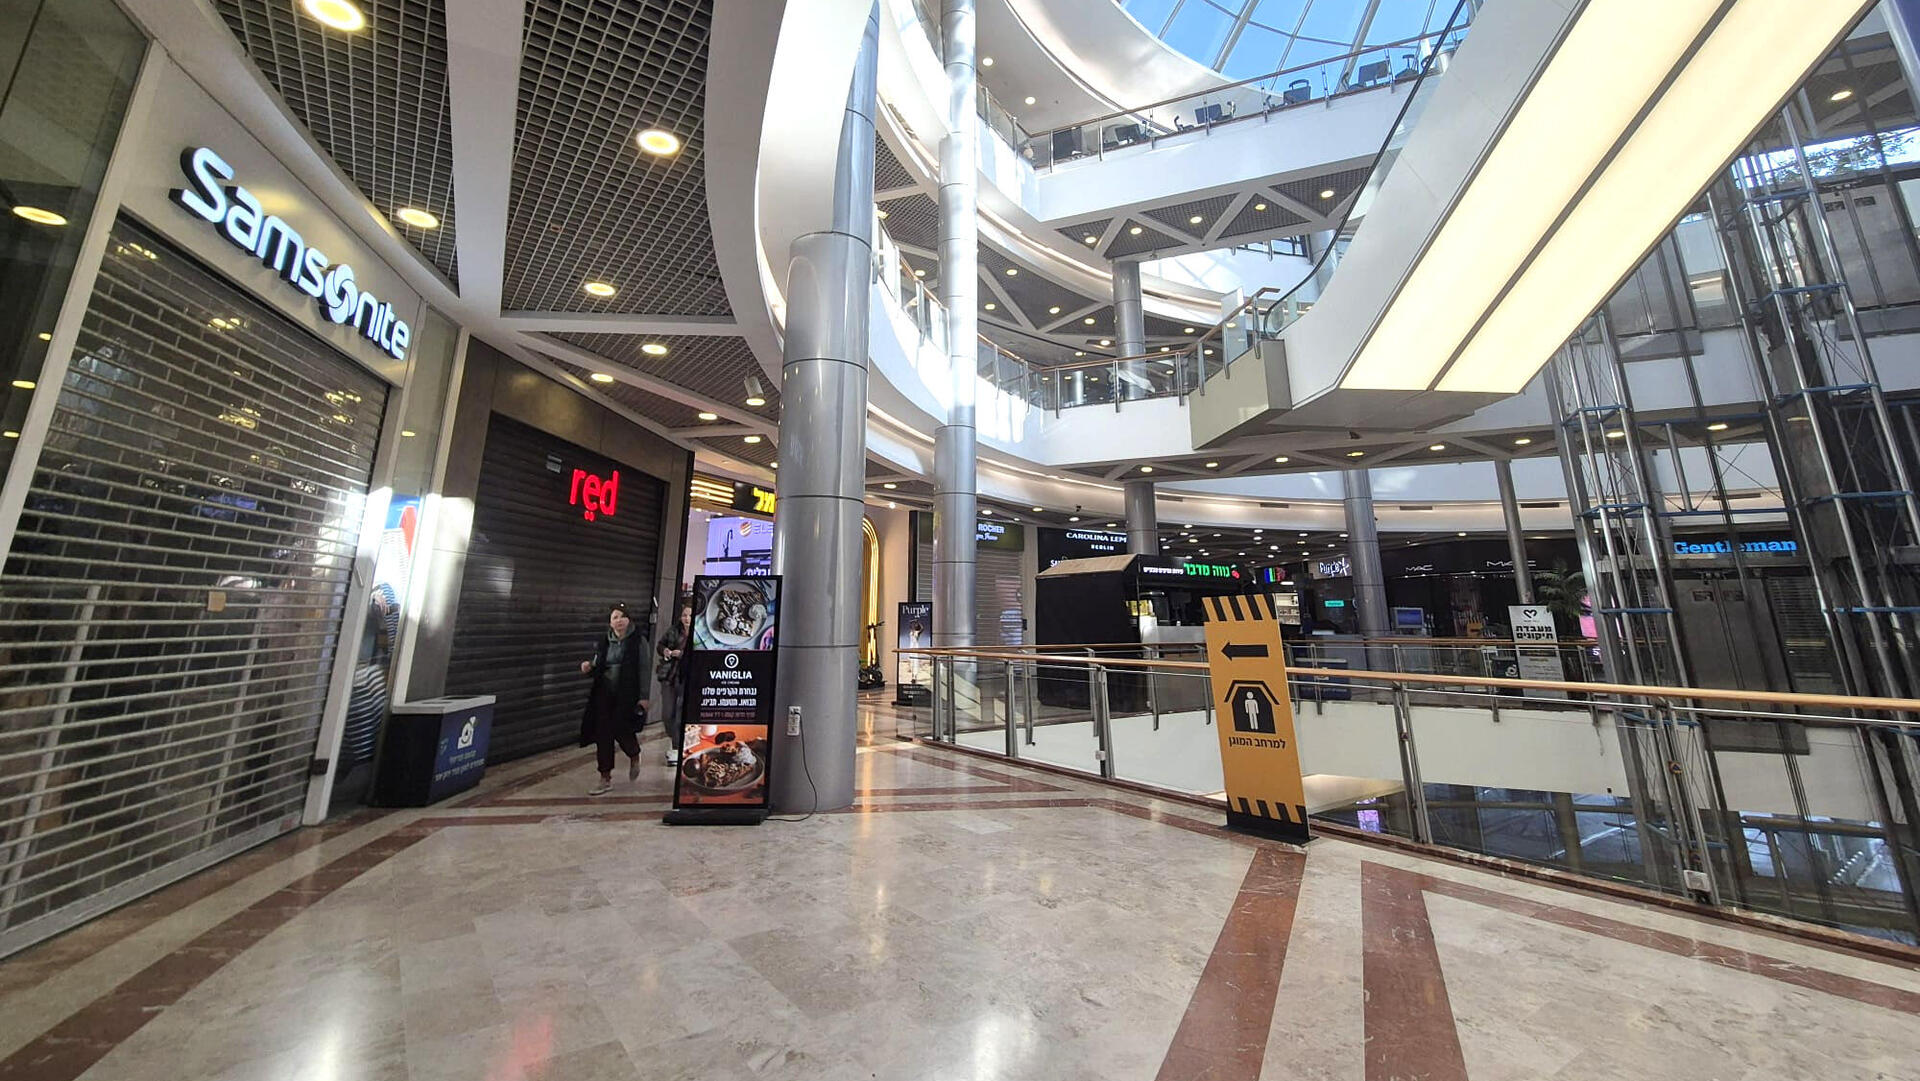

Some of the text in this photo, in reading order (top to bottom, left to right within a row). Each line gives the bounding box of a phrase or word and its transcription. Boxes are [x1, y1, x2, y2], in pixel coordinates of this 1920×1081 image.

[178, 146, 411, 361] Samsonite
[569, 468, 619, 521] red
[1066, 532, 1109, 542] CAROLINA
[1183, 562, 1211, 576] מדבר
[1515, 625, 1553, 633] מעבדת
[709, 670, 753, 680] VANIGLIA
[1228, 736, 1286, 749] למרחב המוגן
